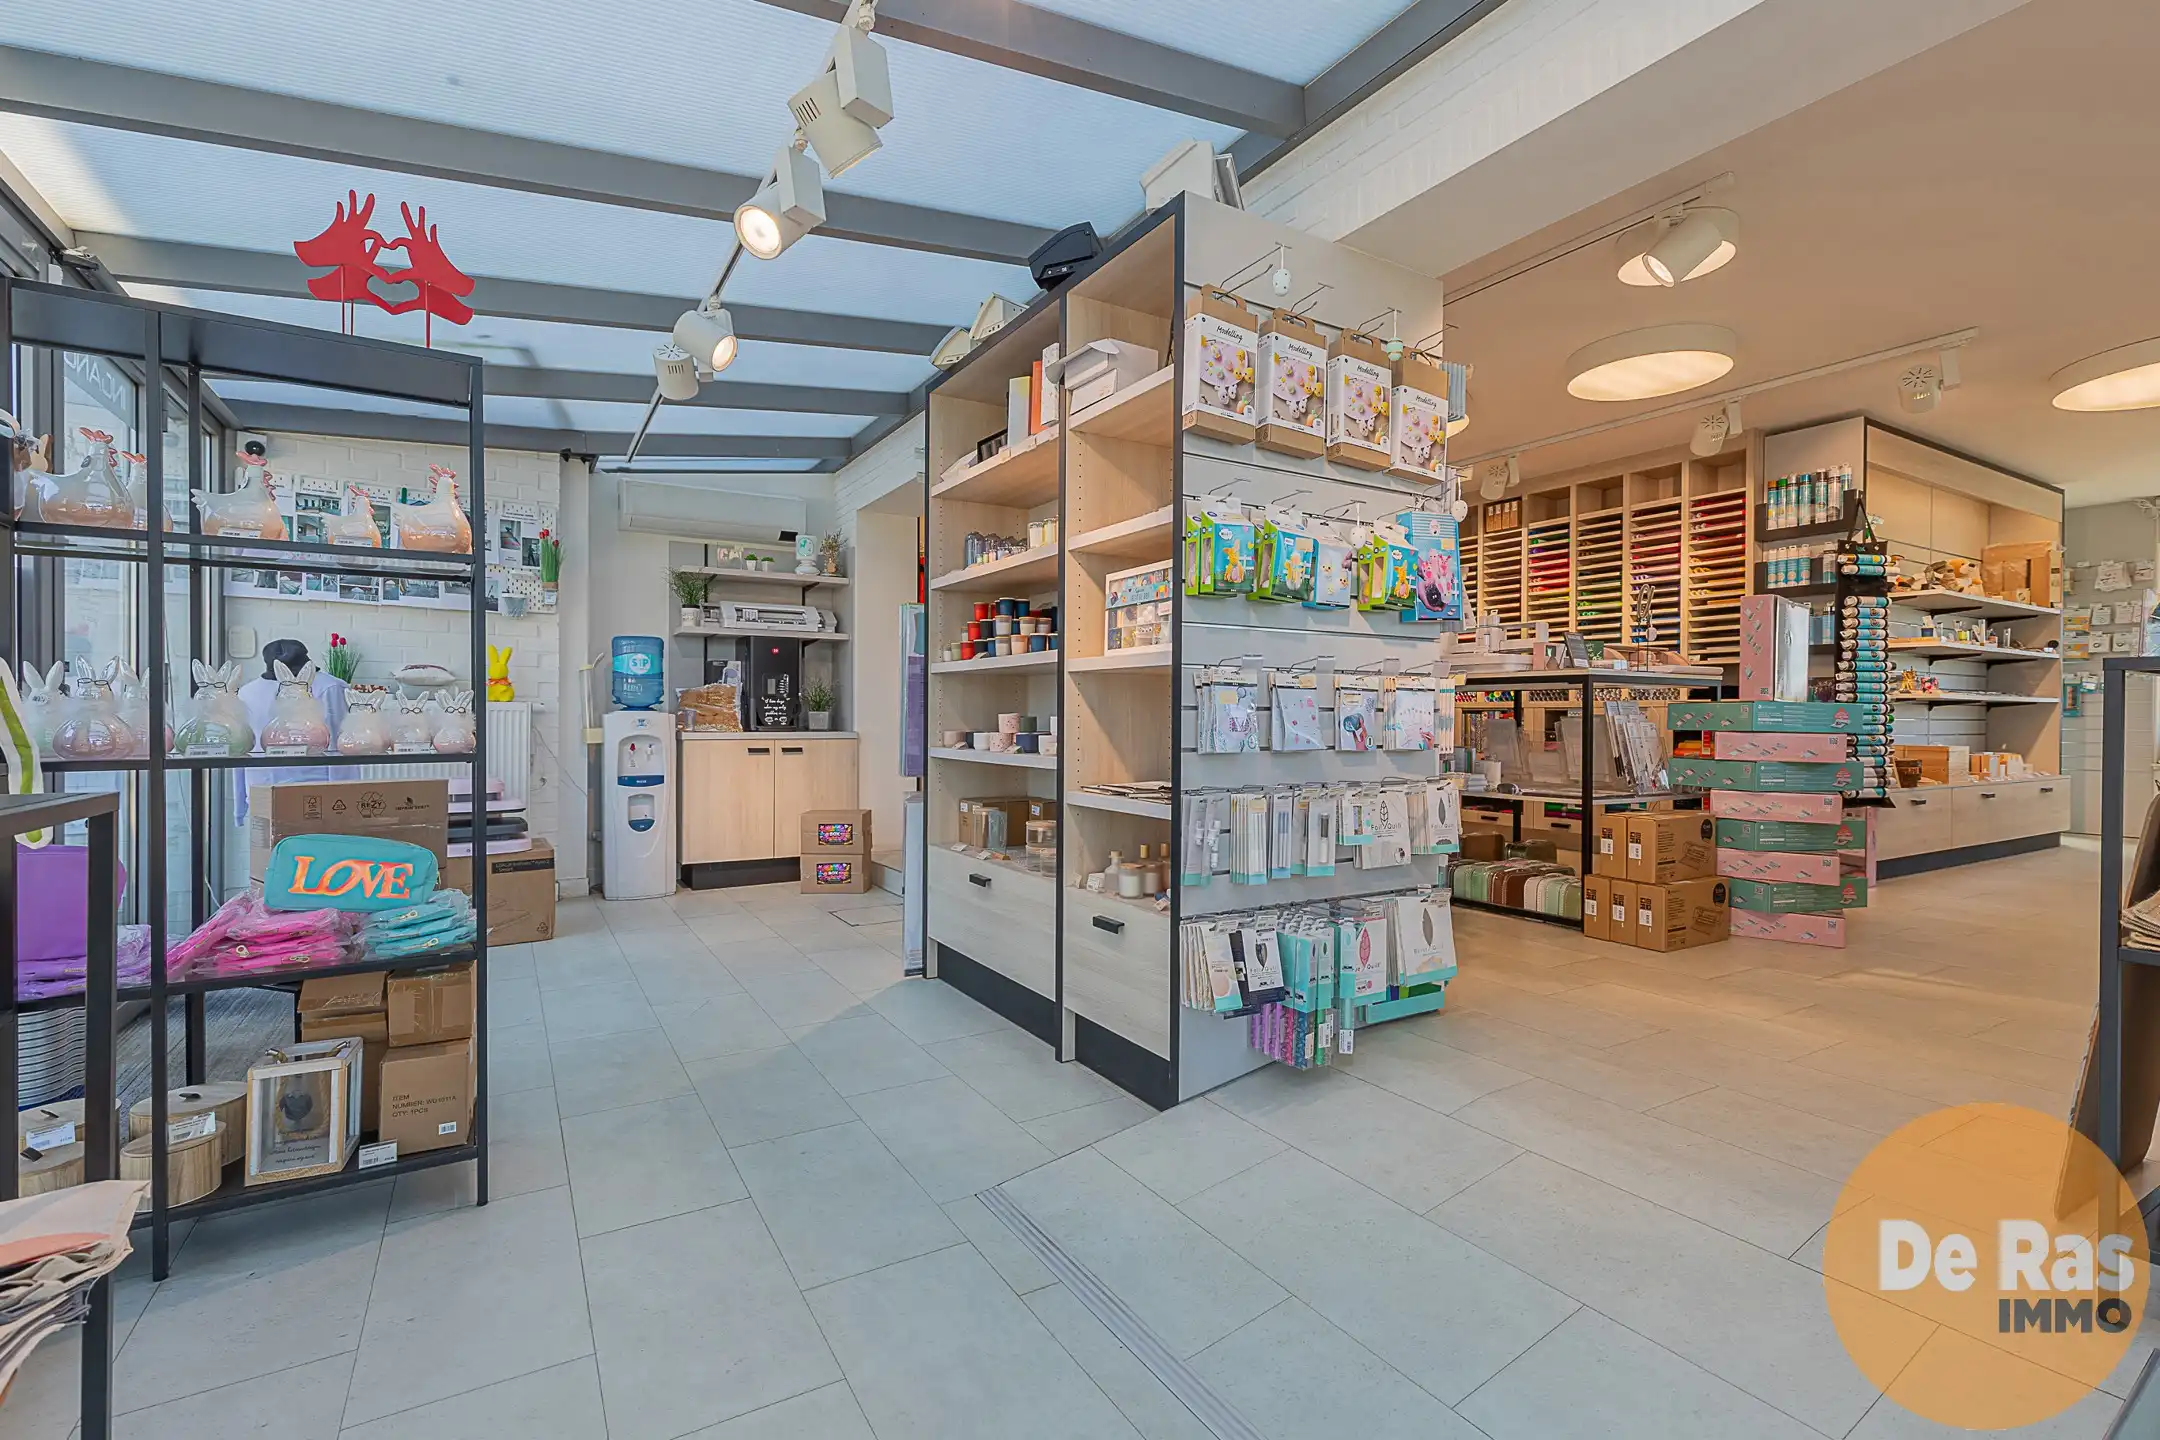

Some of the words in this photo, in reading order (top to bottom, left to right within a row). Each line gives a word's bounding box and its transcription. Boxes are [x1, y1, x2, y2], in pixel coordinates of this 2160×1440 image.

[1216, 325, 1244, 343] Modelling
[1287, 343, 1314, 360] Modelling
[1356, 364, 1380, 380] Modelling
[1415, 394, 1437, 411] Modelling
[287, 855, 414, 899] LOVE
[392, 1094, 410, 1102] ITEM
[392, 1100, 425, 1109] NUMBER:
[410, 1107, 429, 1115] 1PCS
